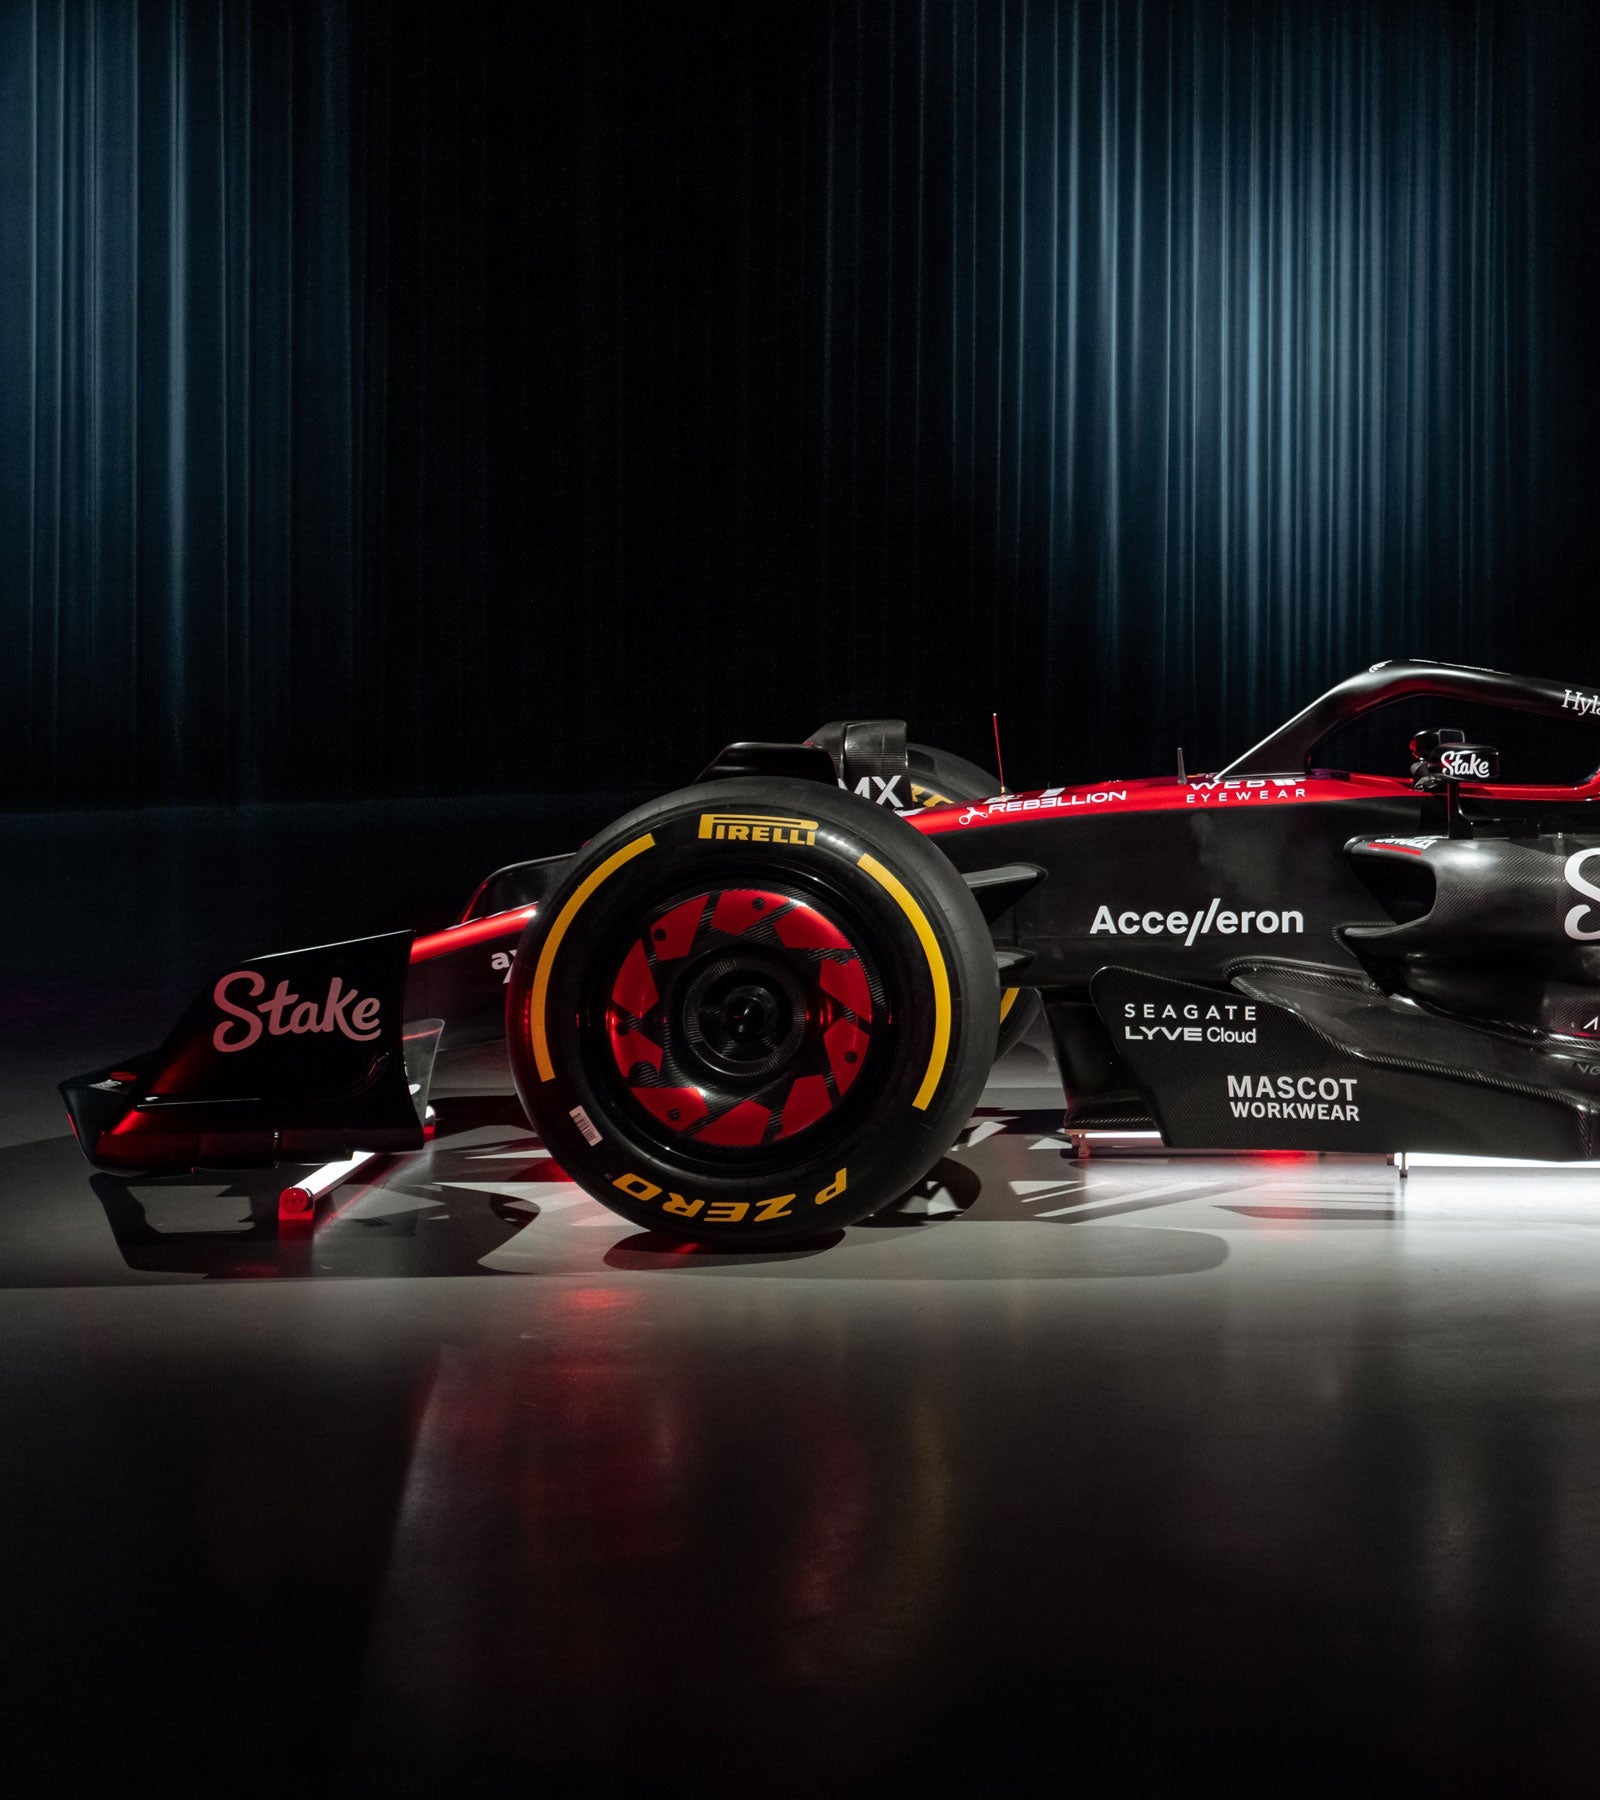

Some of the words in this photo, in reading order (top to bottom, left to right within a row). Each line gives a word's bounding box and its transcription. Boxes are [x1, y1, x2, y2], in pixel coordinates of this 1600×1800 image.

[1440, 751, 1490, 778] Stake
[1186, 788, 1306, 804] EYEWEAR
[698, 814, 819, 846] PIRELLI
[1089, 898, 1304, 947] Accelleron
[213, 970, 382, 1053] Stake
[1124, 1003, 1257, 1021] SEAGATE
[1124, 1025, 1203, 1042] LYVE
[1206, 1026, 1257, 1044] Cloud
[1227, 1075, 1358, 1101] MASCOT
[1229, 1102, 1360, 1122] WORKWEAR
[612, 1173, 797, 1222] ZERO
[814, 1167, 848, 1205] P
